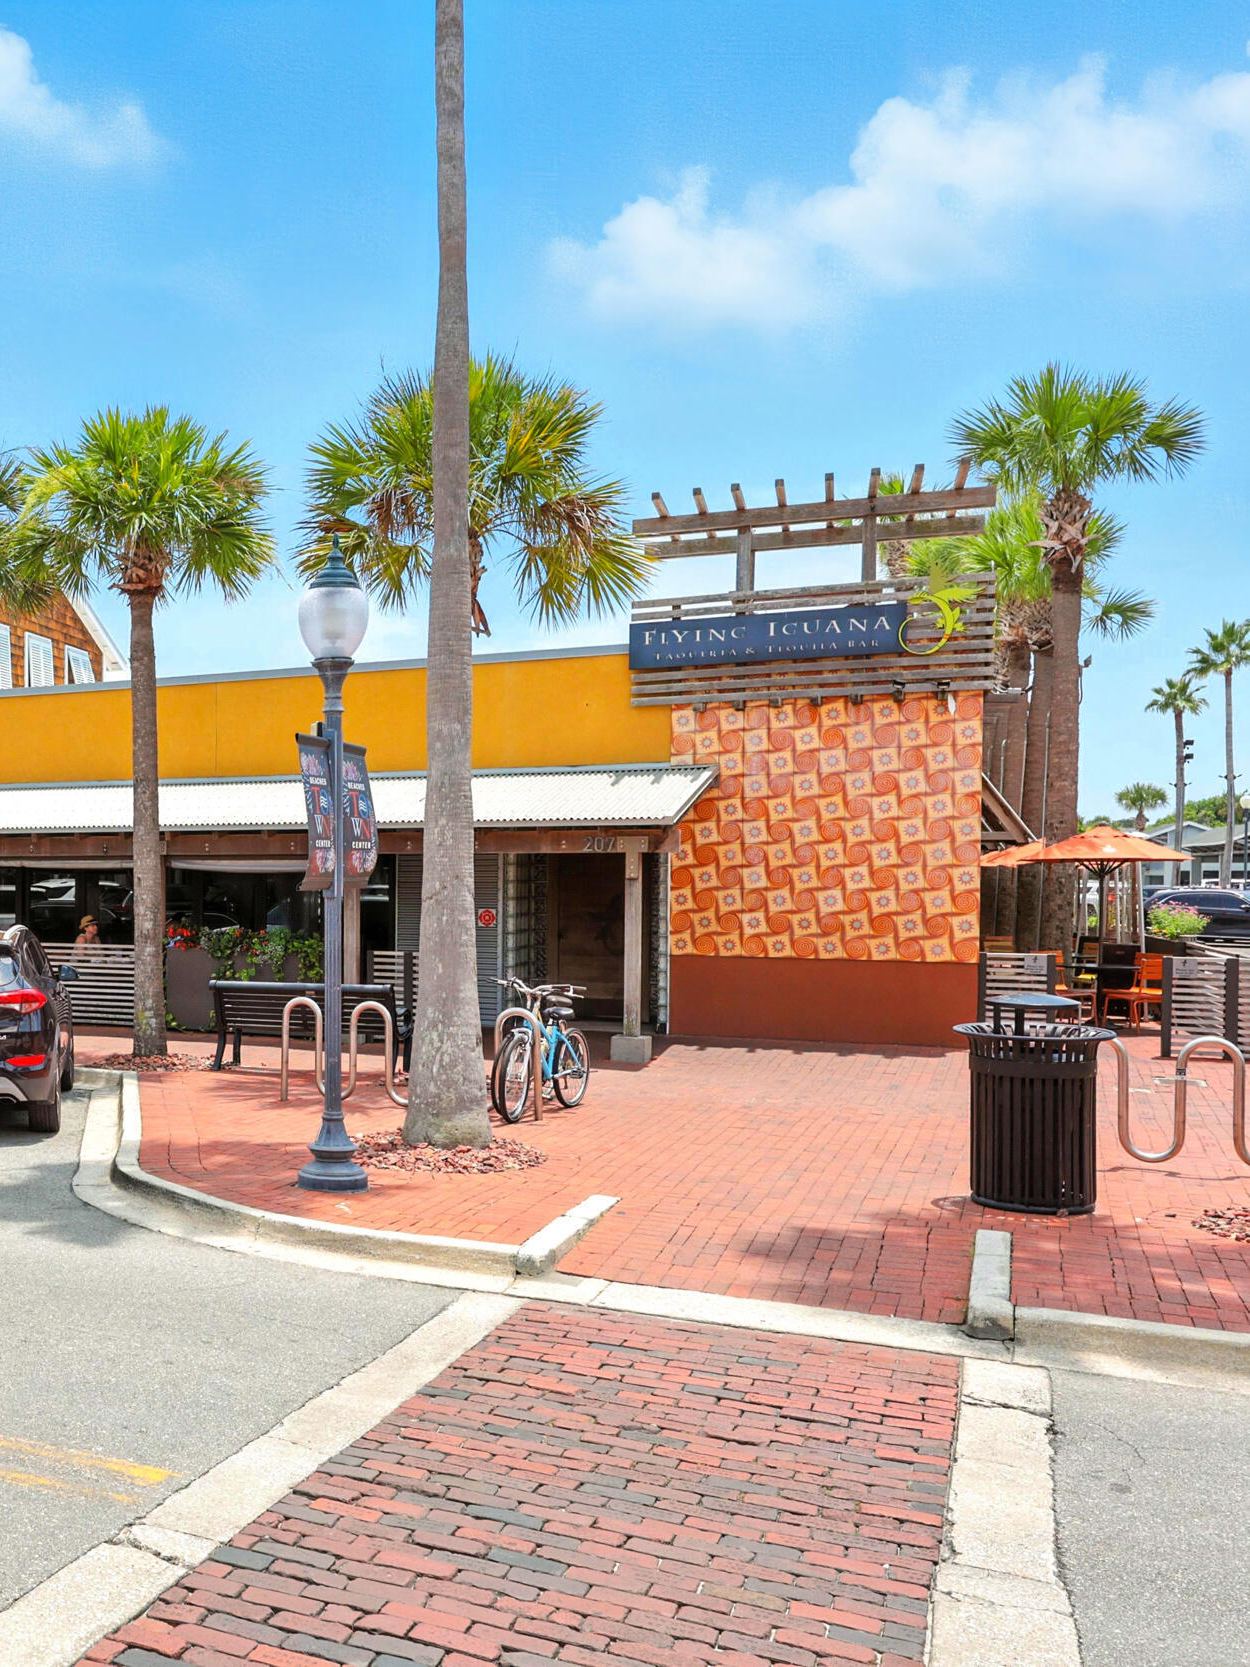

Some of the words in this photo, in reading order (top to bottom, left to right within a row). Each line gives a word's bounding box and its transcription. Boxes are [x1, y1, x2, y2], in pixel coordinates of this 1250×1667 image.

[643, 626, 746, 646] FLYING
[769, 616, 891, 637] IGUANA
[848, 640, 879, 648] BAR
[315, 840, 331, 848] CENTER
[352, 841, 371, 849] CENTER
[583, 836, 615, 851] 207
